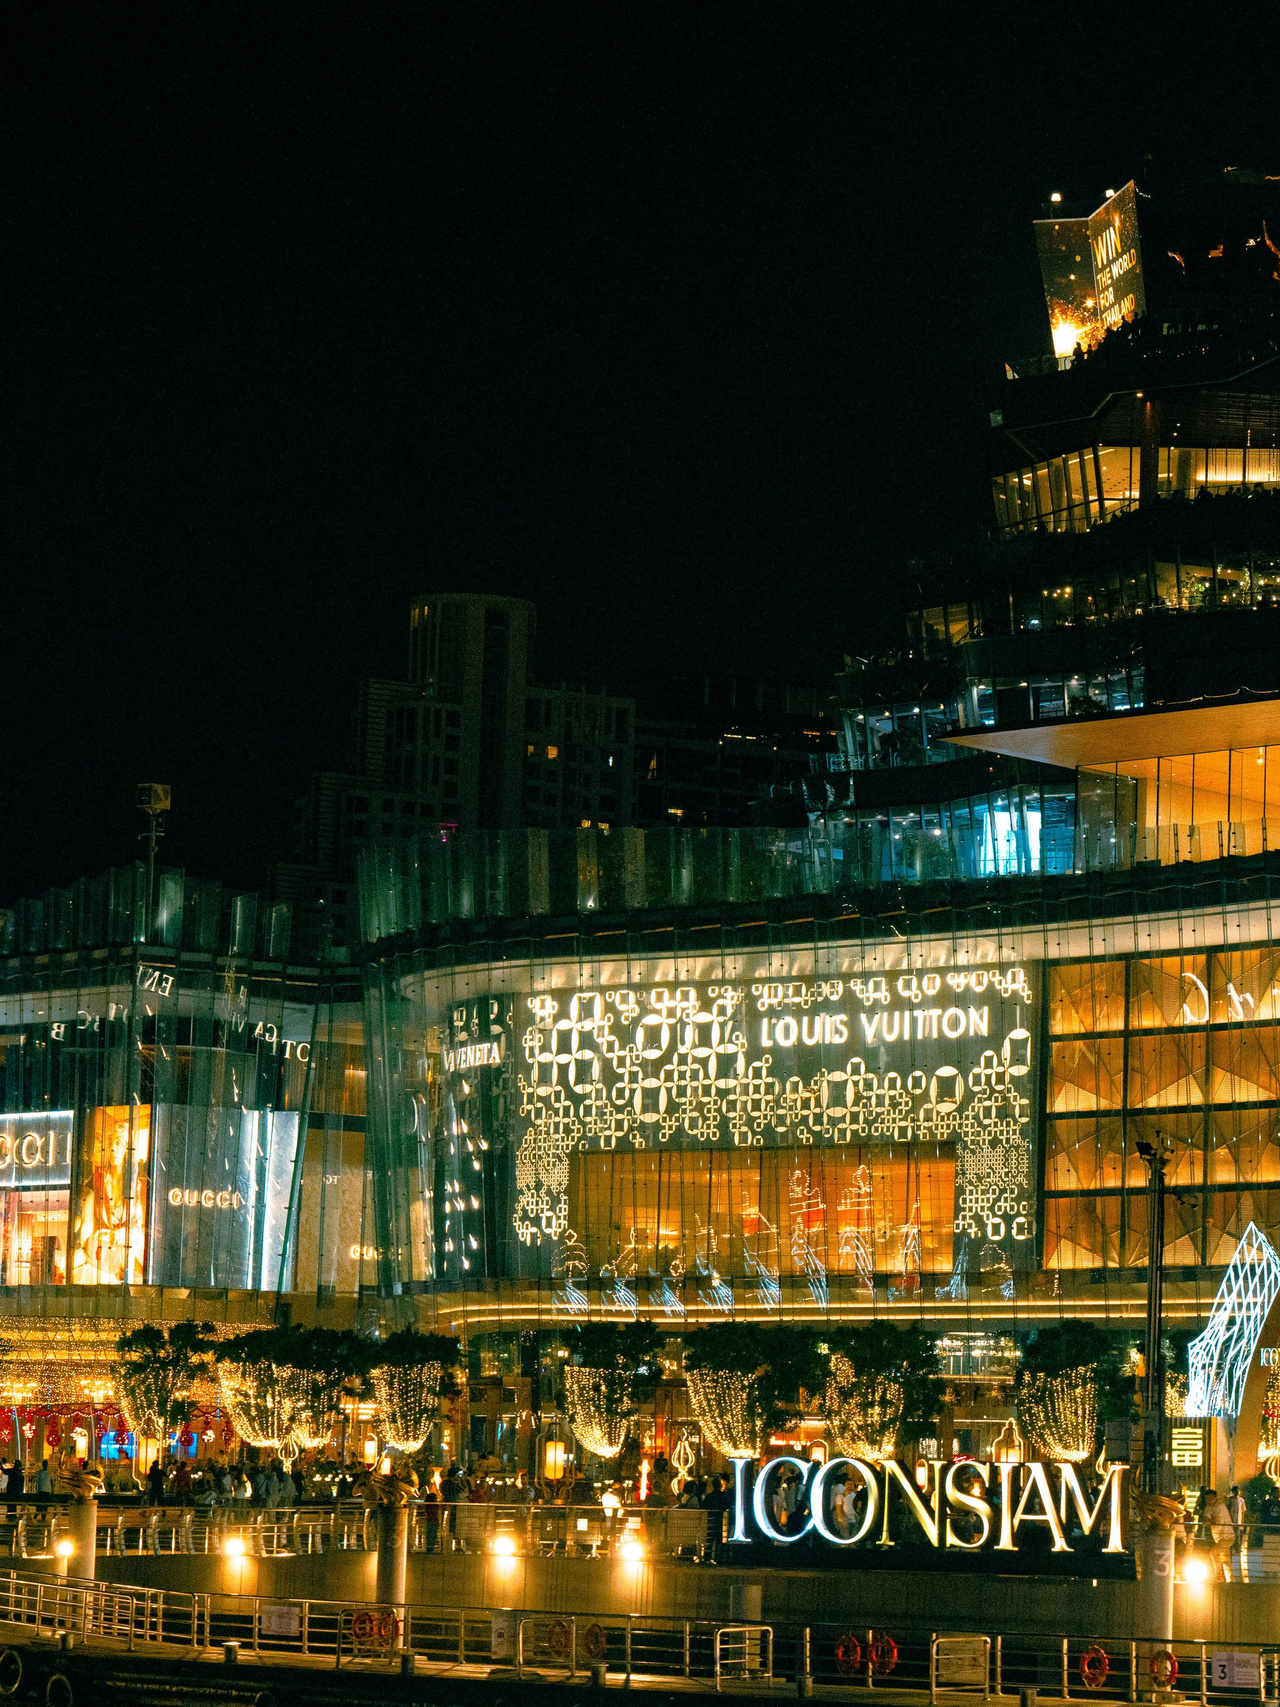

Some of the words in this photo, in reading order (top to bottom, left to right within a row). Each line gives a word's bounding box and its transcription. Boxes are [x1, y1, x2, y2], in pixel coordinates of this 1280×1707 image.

[1093, 223, 1122, 269] WIN
[1097, 268, 1112, 291] THE
[1111, 248, 1137, 279] WORLD
[1100, 286, 1115, 311] FOR
[1102, 293, 1136, 329] THAILAND
[761, 1013, 849, 1048] LOUIS
[860, 1005, 989, 1044] VUITTON
[168, 1187, 240, 1209] GUCCI
[728, 1457, 1129, 1553] ICONSIAM
[1152, 1549, 1169, 1577] 3
[1218, 1664, 1227, 1680] 3
